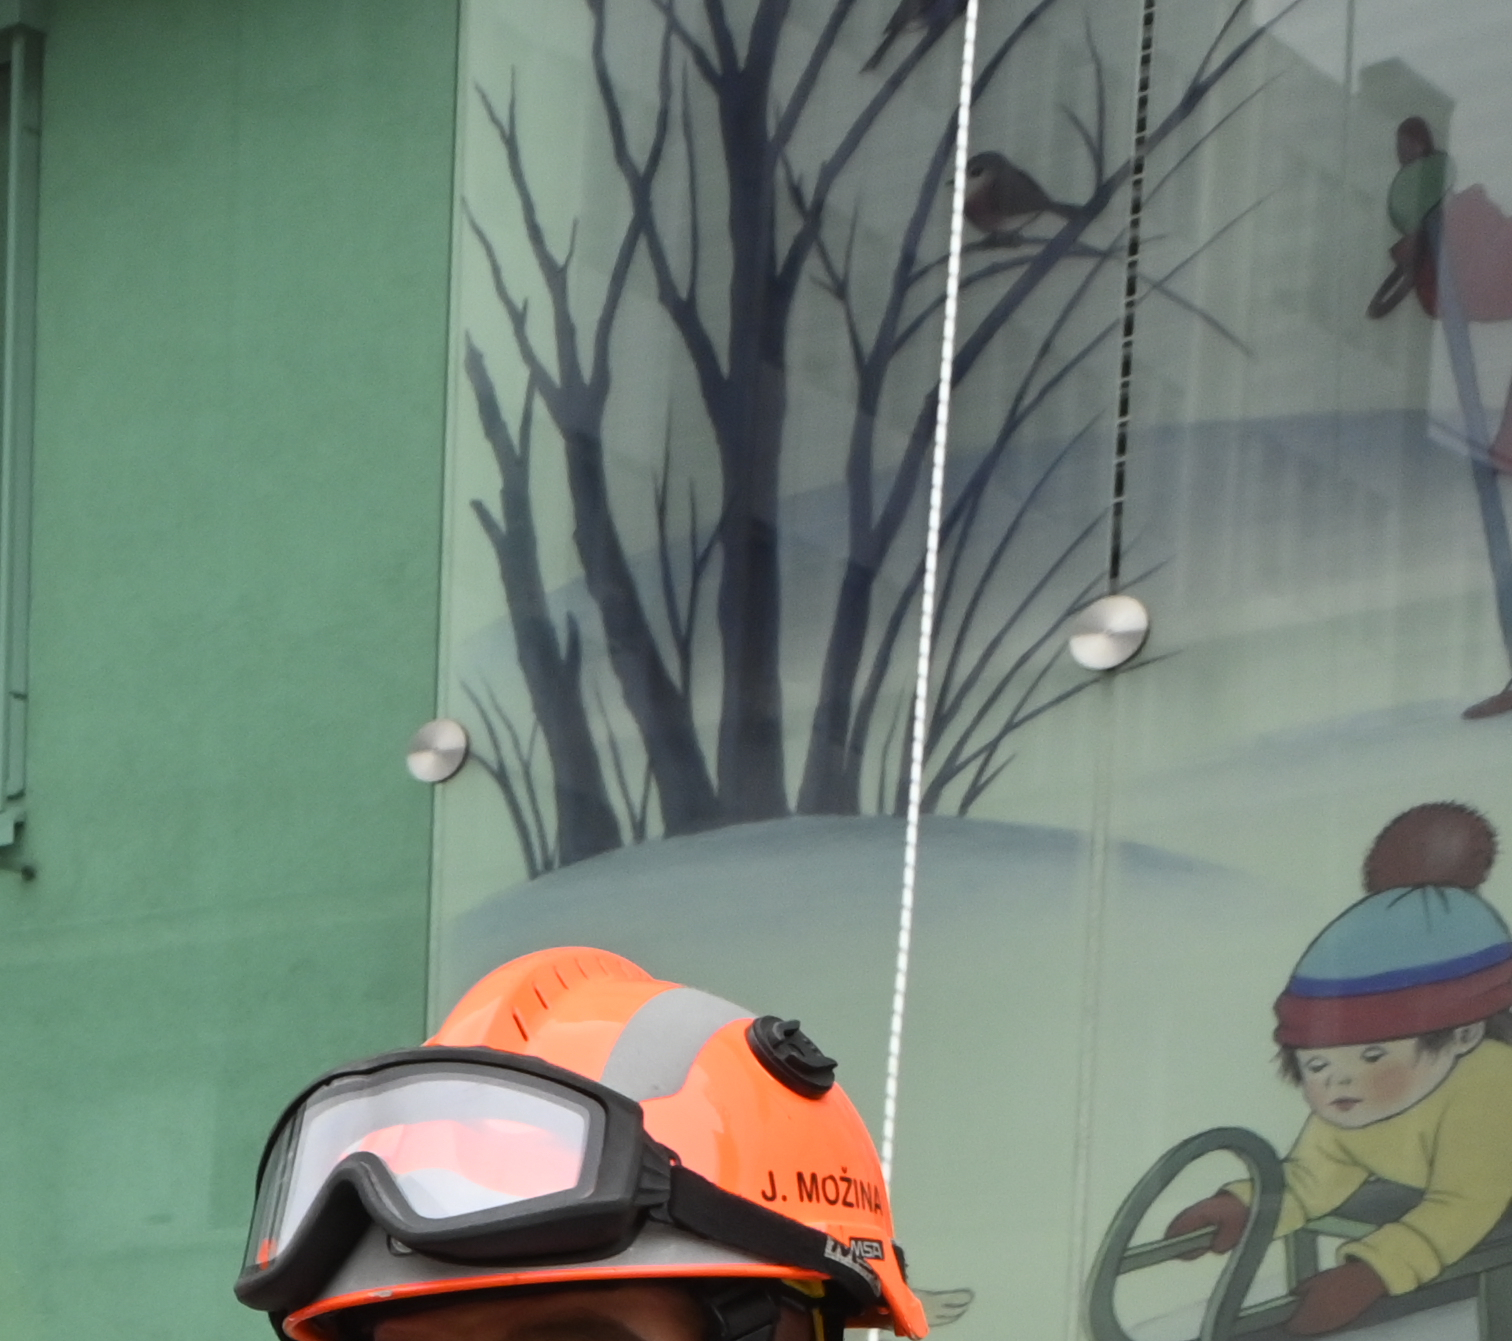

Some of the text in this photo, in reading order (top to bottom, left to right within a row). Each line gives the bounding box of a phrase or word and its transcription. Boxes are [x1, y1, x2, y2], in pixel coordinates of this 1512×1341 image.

[761, 1166, 884, 1216] J. MOŽINA
[850, 1239, 883, 1259] MSA
